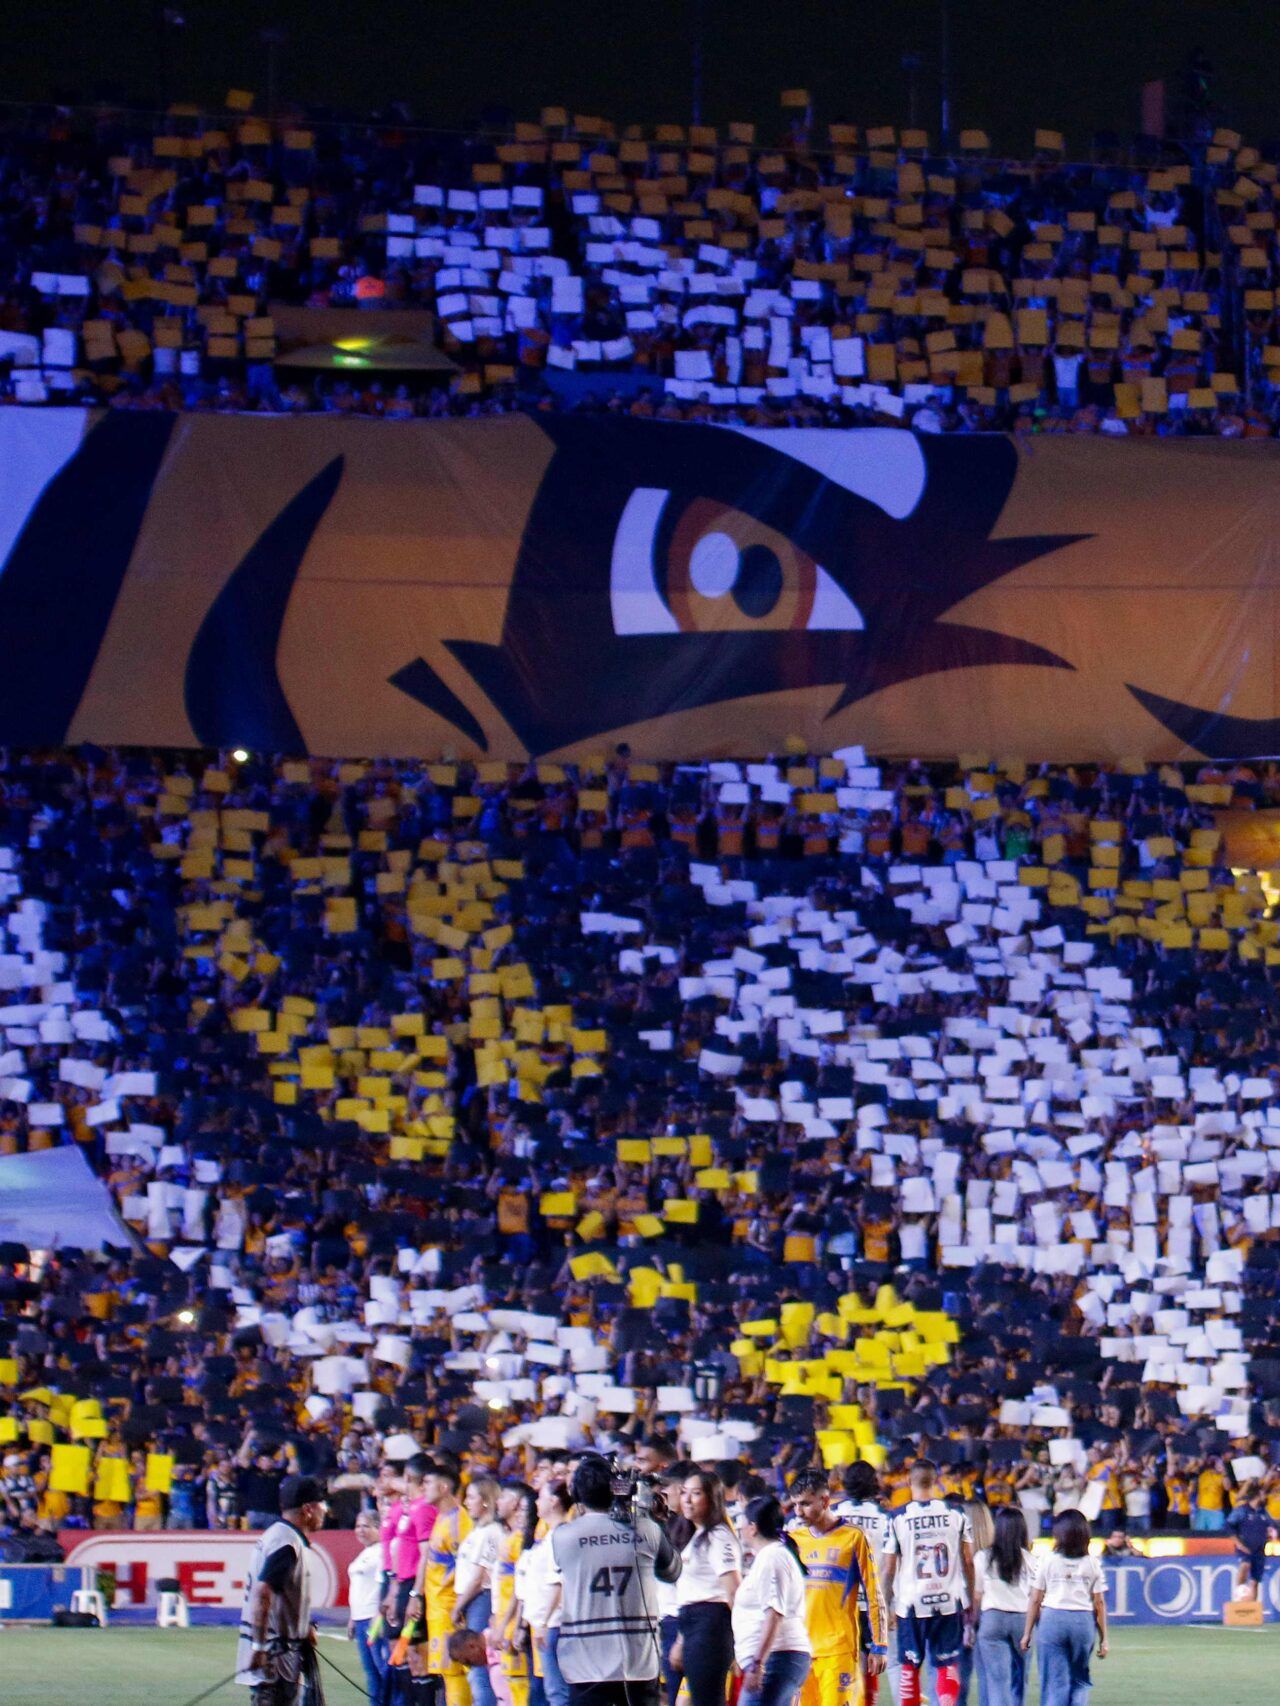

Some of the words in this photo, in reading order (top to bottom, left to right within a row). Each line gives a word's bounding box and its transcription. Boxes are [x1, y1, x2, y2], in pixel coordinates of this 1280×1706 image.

[907, 1515, 950, 1531] TECATE
[915, 1543, 949, 1579] 20
[589, 1566, 633, 1597] 47
